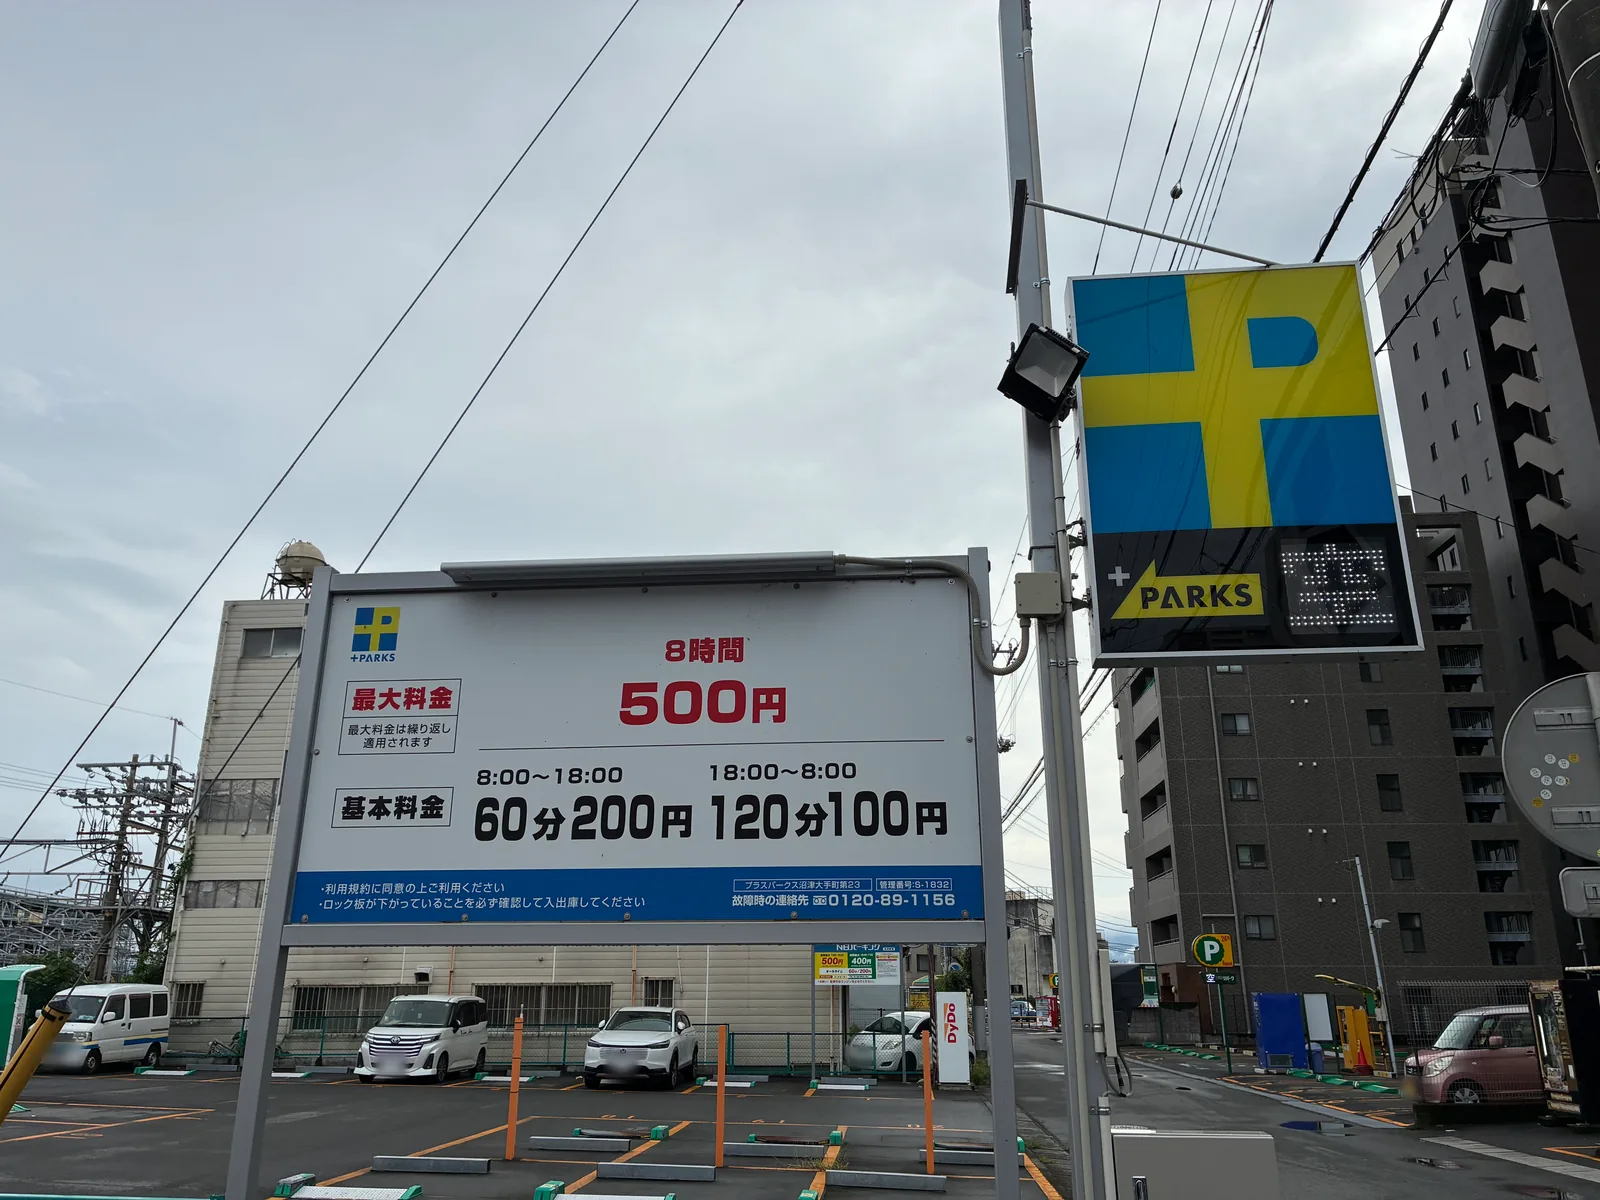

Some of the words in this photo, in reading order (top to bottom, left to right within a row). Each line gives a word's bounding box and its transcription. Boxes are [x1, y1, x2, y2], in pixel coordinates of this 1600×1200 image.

[1140, 584, 1253, 609] PARKS
[665, 637, 744, 663] 8時間
[352, 686, 453, 712] 最大料金
[619, 679, 787, 725] 500円
[348, 723, 451, 736] 最大料金は繰り返し
[363, 737, 433, 749] 適用されます
[341, 795, 445, 821] 基本料金
[745, 880, 861, 890] プラスパークス沼津大手町第23
[732, 894, 809, 906] 故障時の連絡先
[829, 893, 956, 906] 0120-89-1156
[1203, 940, 1220, 961] P
[947, 1003, 959, 1044] DyDo
